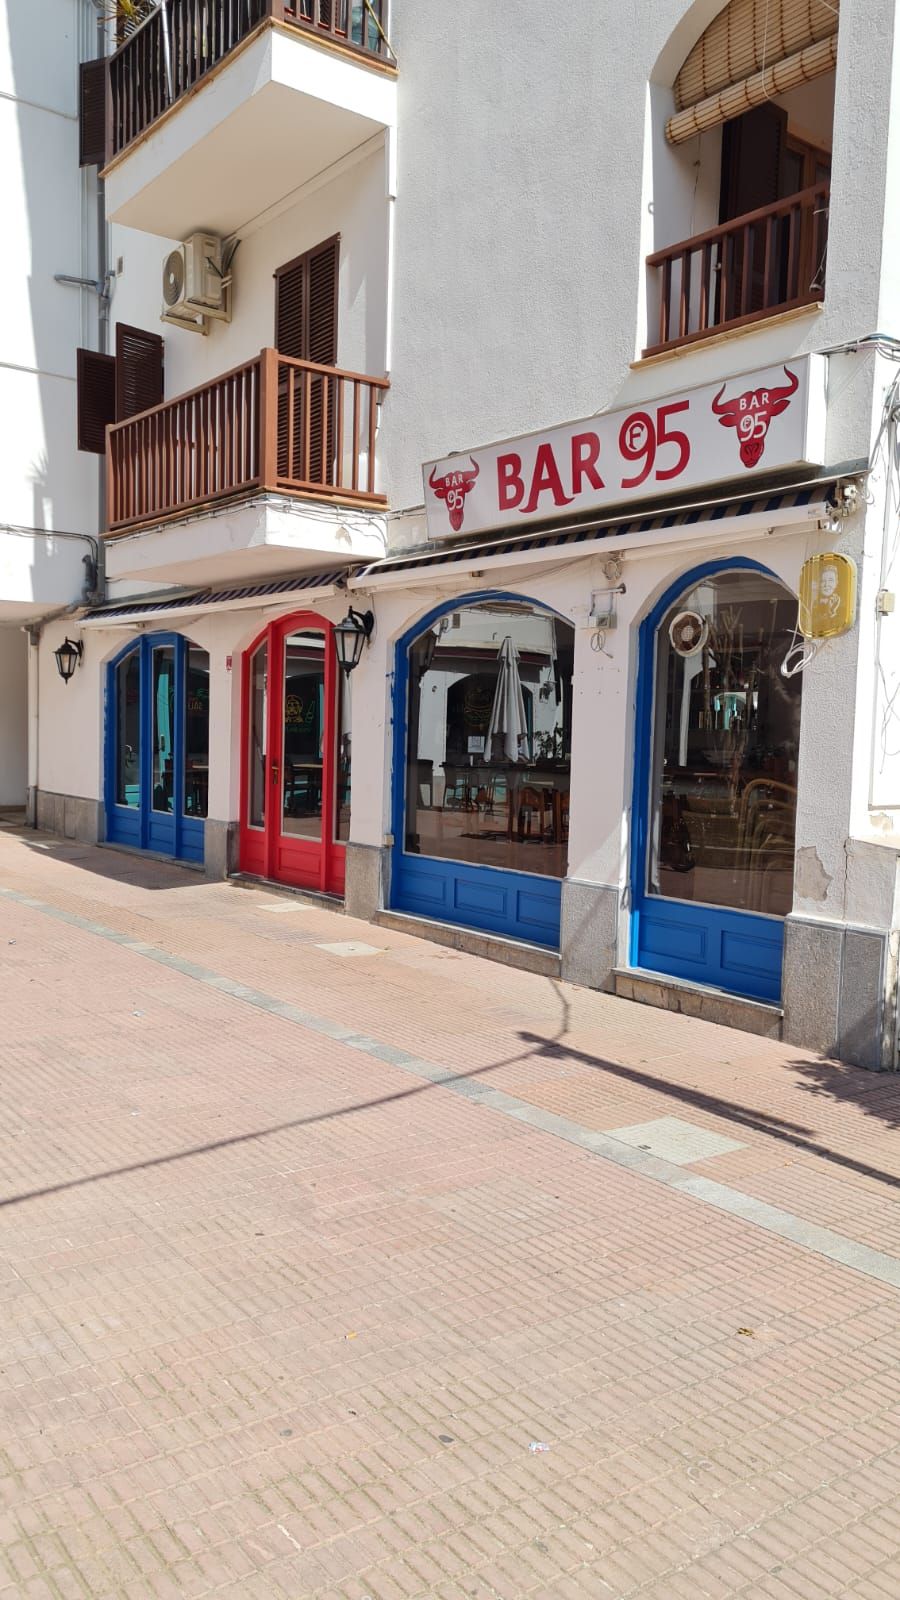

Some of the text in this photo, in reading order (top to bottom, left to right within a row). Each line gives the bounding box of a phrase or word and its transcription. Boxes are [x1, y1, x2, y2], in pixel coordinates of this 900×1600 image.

[739, 392, 770, 411] BAR
[740, 411, 768, 442] 95
[496, 399, 691, 514] BAR 95
[445, 474, 464, 487] BAR
[447, 488, 464, 511] 95
